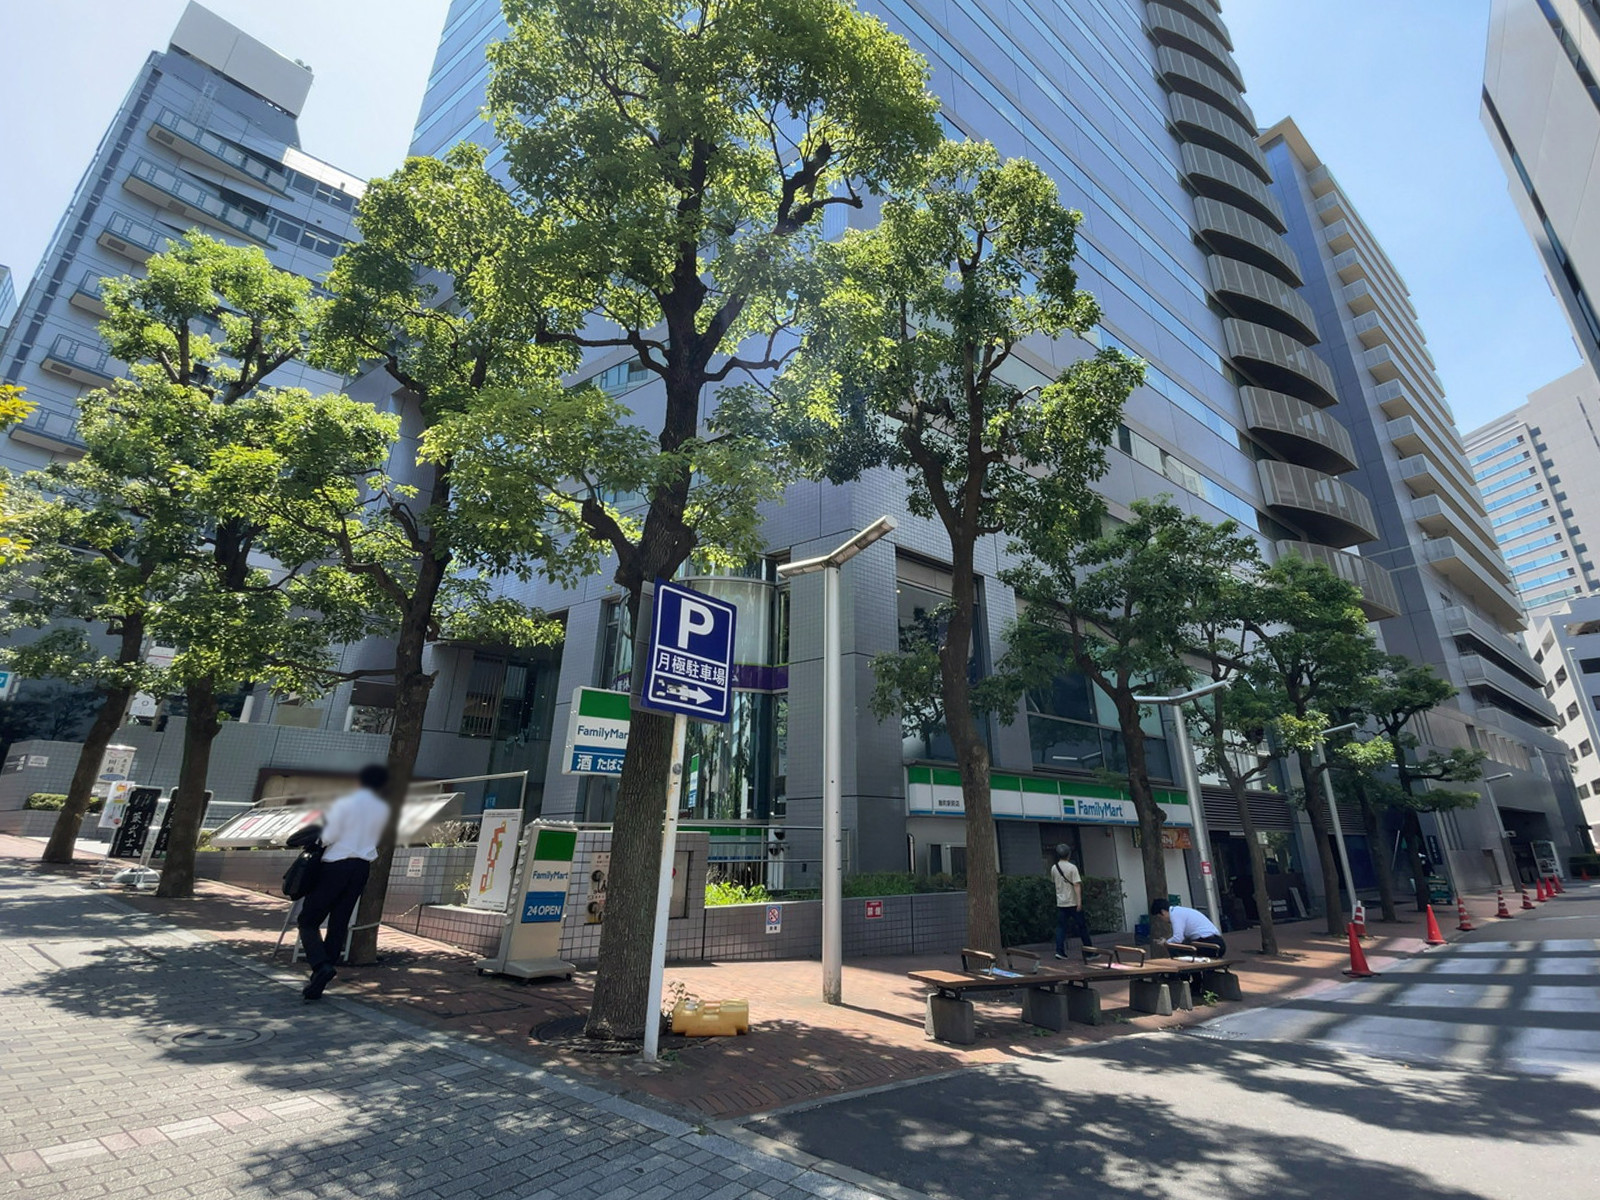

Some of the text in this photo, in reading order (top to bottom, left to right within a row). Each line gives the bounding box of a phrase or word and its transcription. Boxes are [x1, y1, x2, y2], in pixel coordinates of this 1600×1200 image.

[677, 598, 715, 650] P
[657, 652, 727, 686] 月極駐車場
[577, 724, 629, 741] FamilyMar
[576, 754, 625, 772] 酒 たばこ
[1077, 800, 1124, 819] FamilyMart
[532, 870, 569, 882] FamilyMart
[527, 905, 562, 916] 24 OPEN
